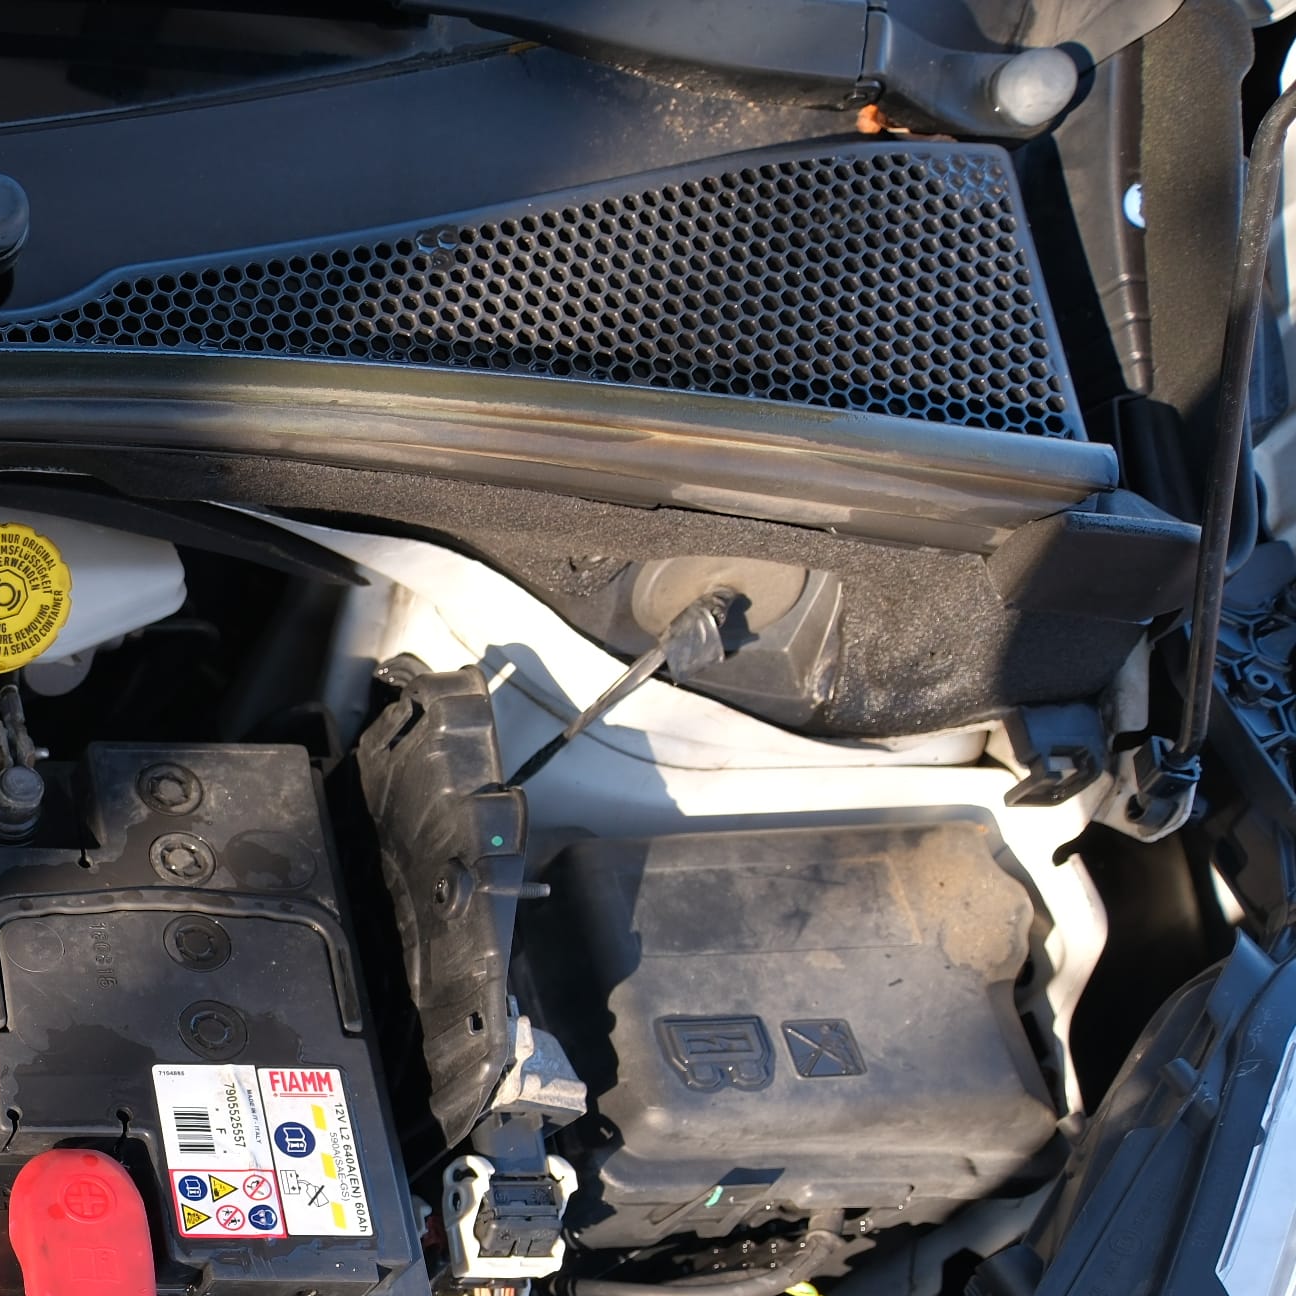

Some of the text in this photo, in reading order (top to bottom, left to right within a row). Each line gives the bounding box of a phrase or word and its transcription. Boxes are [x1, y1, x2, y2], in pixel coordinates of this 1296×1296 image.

[1, 533, 56, 571] NUR ORIGINAL
[3, 646, 9, 657] A
[10, 634, 41, 655] SEALED
[39, 590, 63, 638] CONTAINER
[15, 604, 50, 640] REMOVING
[269, 1070, 334, 1093] FIAMM
[222, 1082, 248, 1147] 7905525557
[246, 1089, 255, 1107] MADE
[252, 1125, 262, 1144] ITALY
[328, 1132, 351, 1202] 590A(SAE-GS)
[333, 1102, 369, 1232] 12V L2 640A(EN) 60Ah
